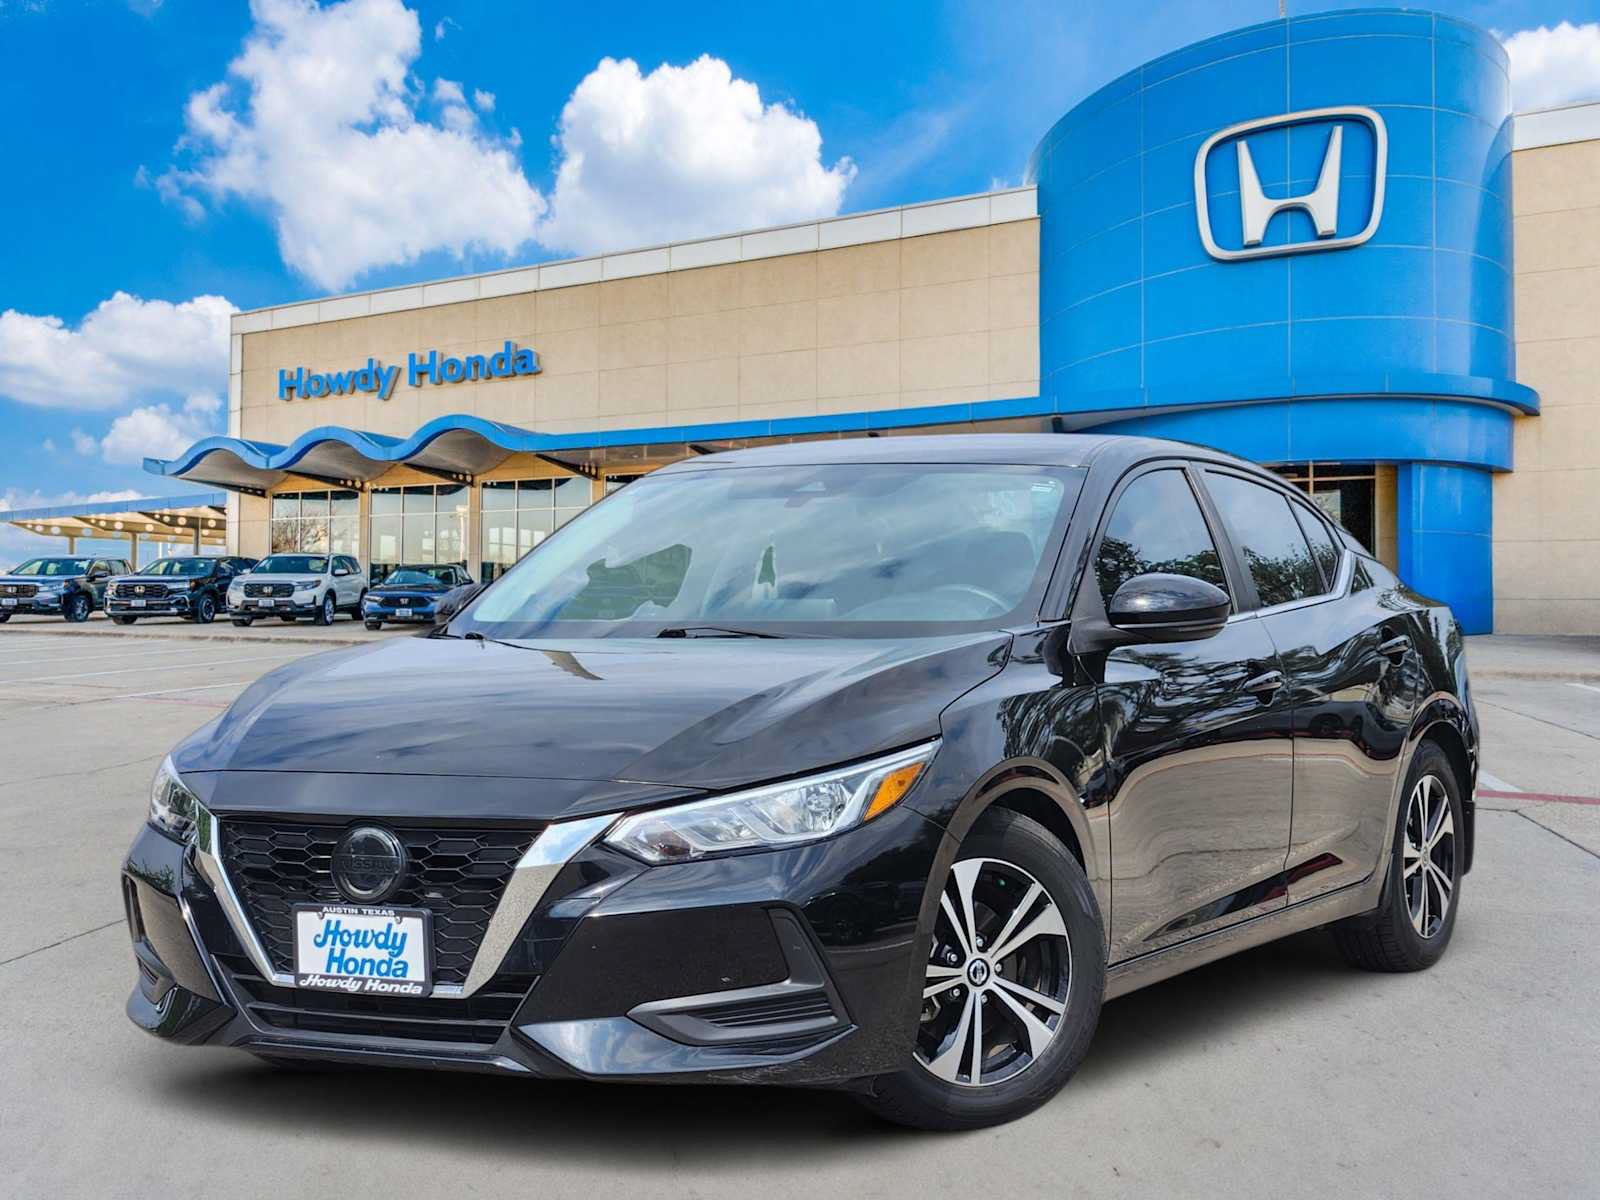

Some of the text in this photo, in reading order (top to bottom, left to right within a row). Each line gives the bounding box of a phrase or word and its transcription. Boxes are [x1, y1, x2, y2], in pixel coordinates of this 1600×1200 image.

[278, 341, 541, 400] Howdy Honda
[322, 906, 396, 917] AUSTIN TEXAS
[313, 919, 408, 958] Howdy
[325, 948, 409, 978] Honda
[300, 974, 423, 995] Howdy Honda
